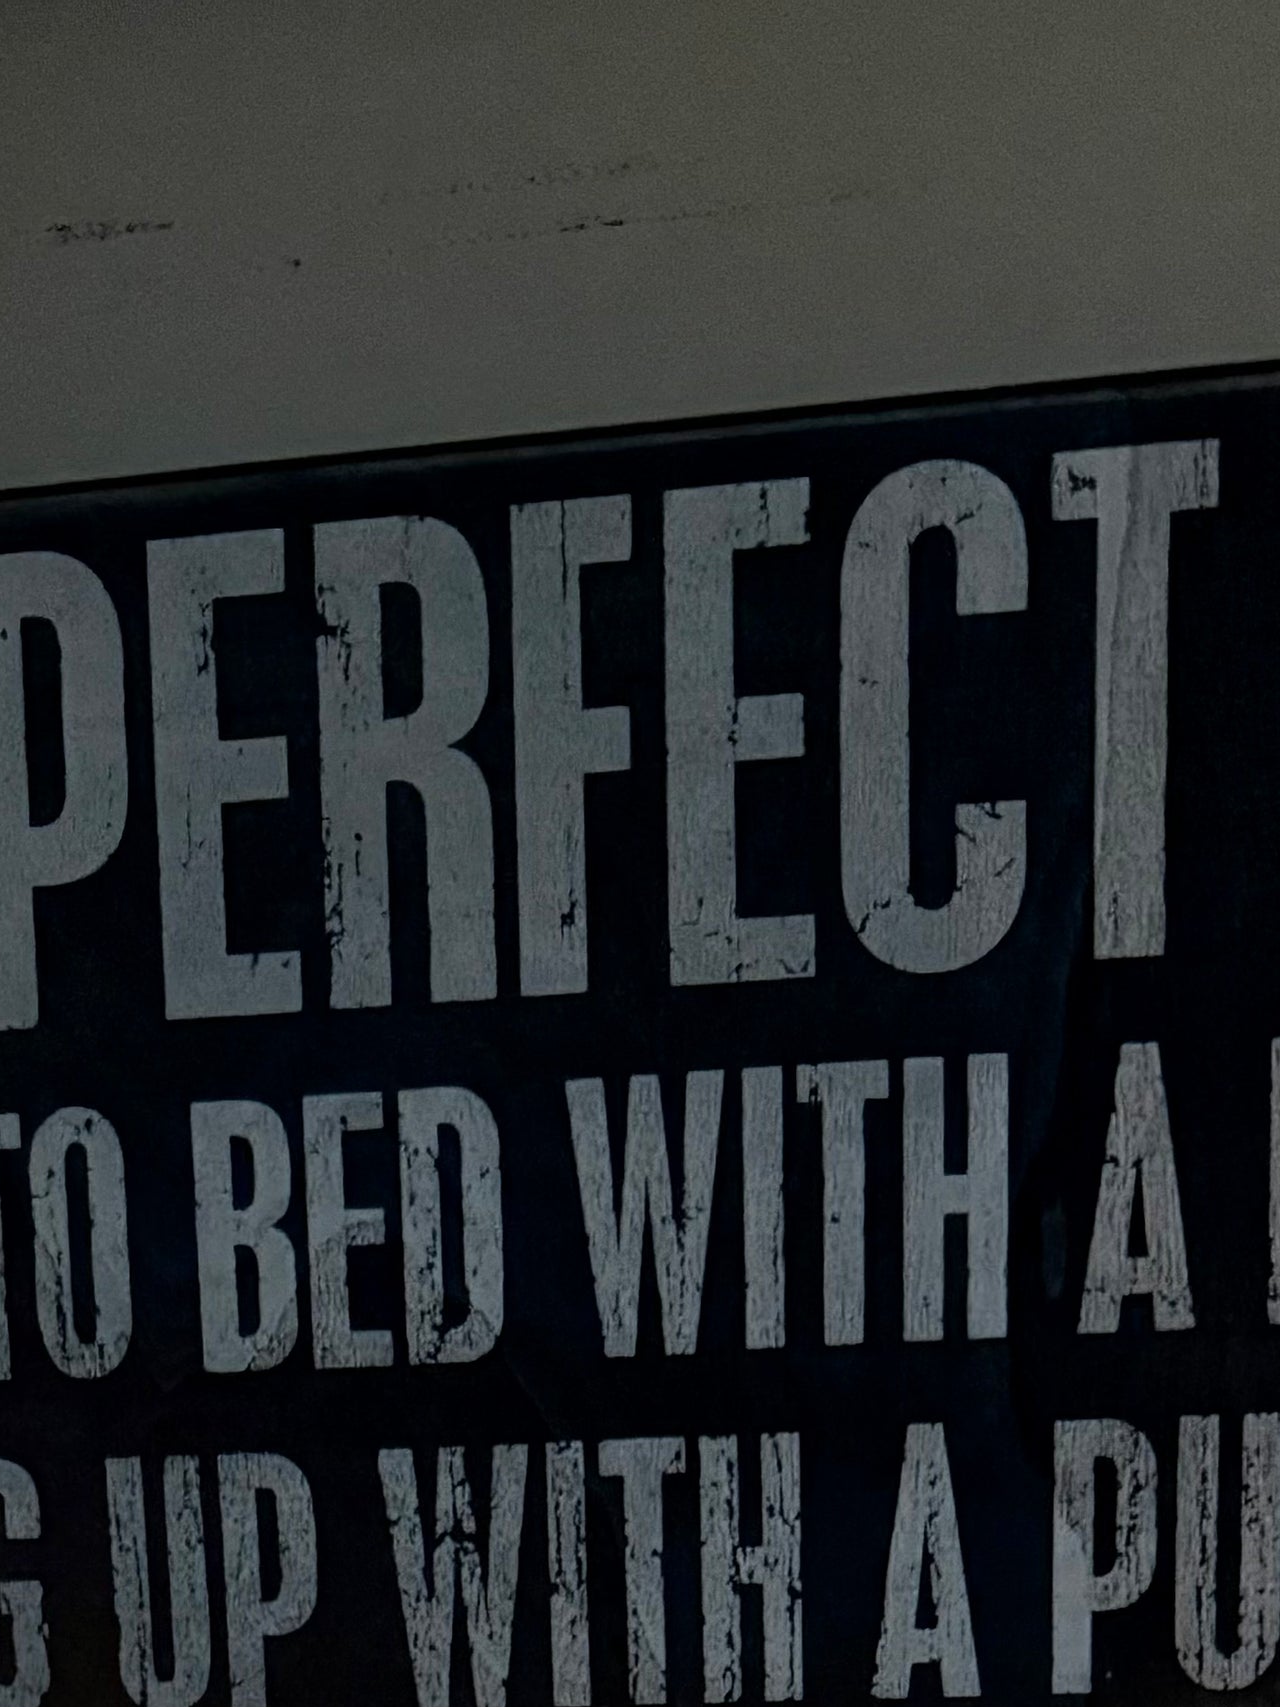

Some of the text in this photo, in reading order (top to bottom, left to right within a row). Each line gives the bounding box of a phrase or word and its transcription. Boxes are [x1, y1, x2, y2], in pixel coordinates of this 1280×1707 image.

[189, 1085, 505, 1373] BED
[565, 1052, 1009, 1358] WITH
[1076, 1041, 1195, 1334] A
[871, 1422, 981, 1700] A
